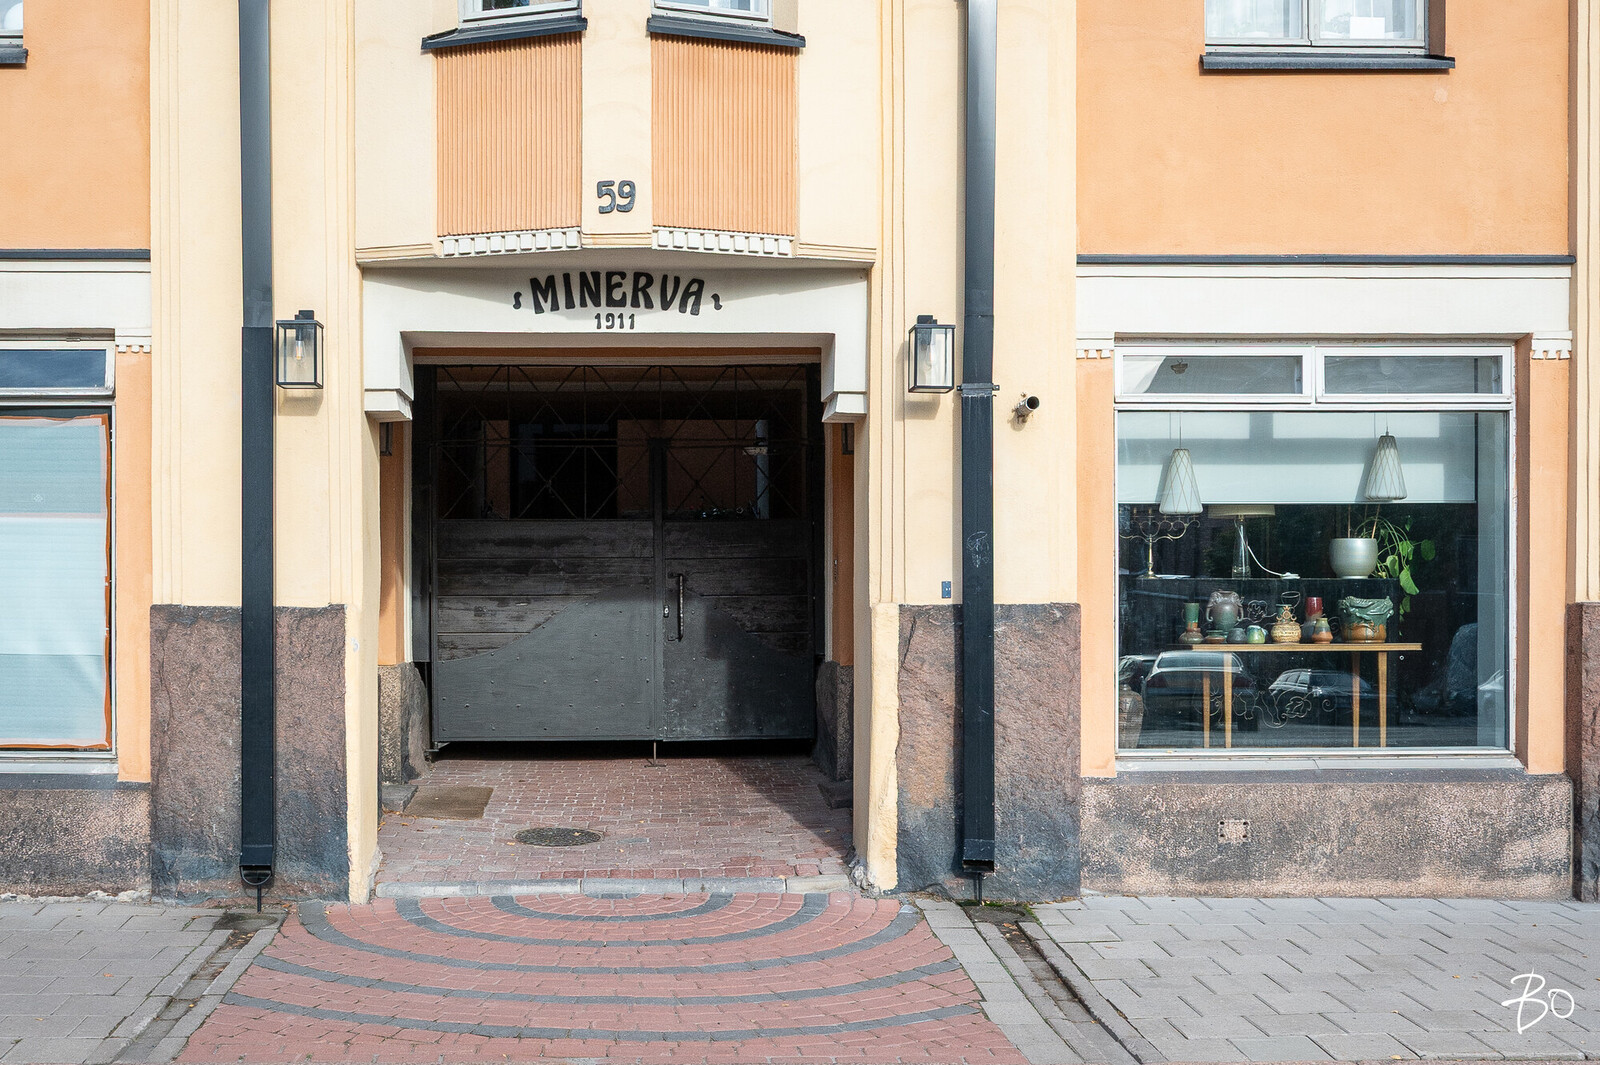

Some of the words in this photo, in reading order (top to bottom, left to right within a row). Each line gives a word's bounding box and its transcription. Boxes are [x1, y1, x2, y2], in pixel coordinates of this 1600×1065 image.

[597, 180, 636, 214] 59
[529, 271, 705, 316] MINERVA
[594, 312, 636, 330] 1911
